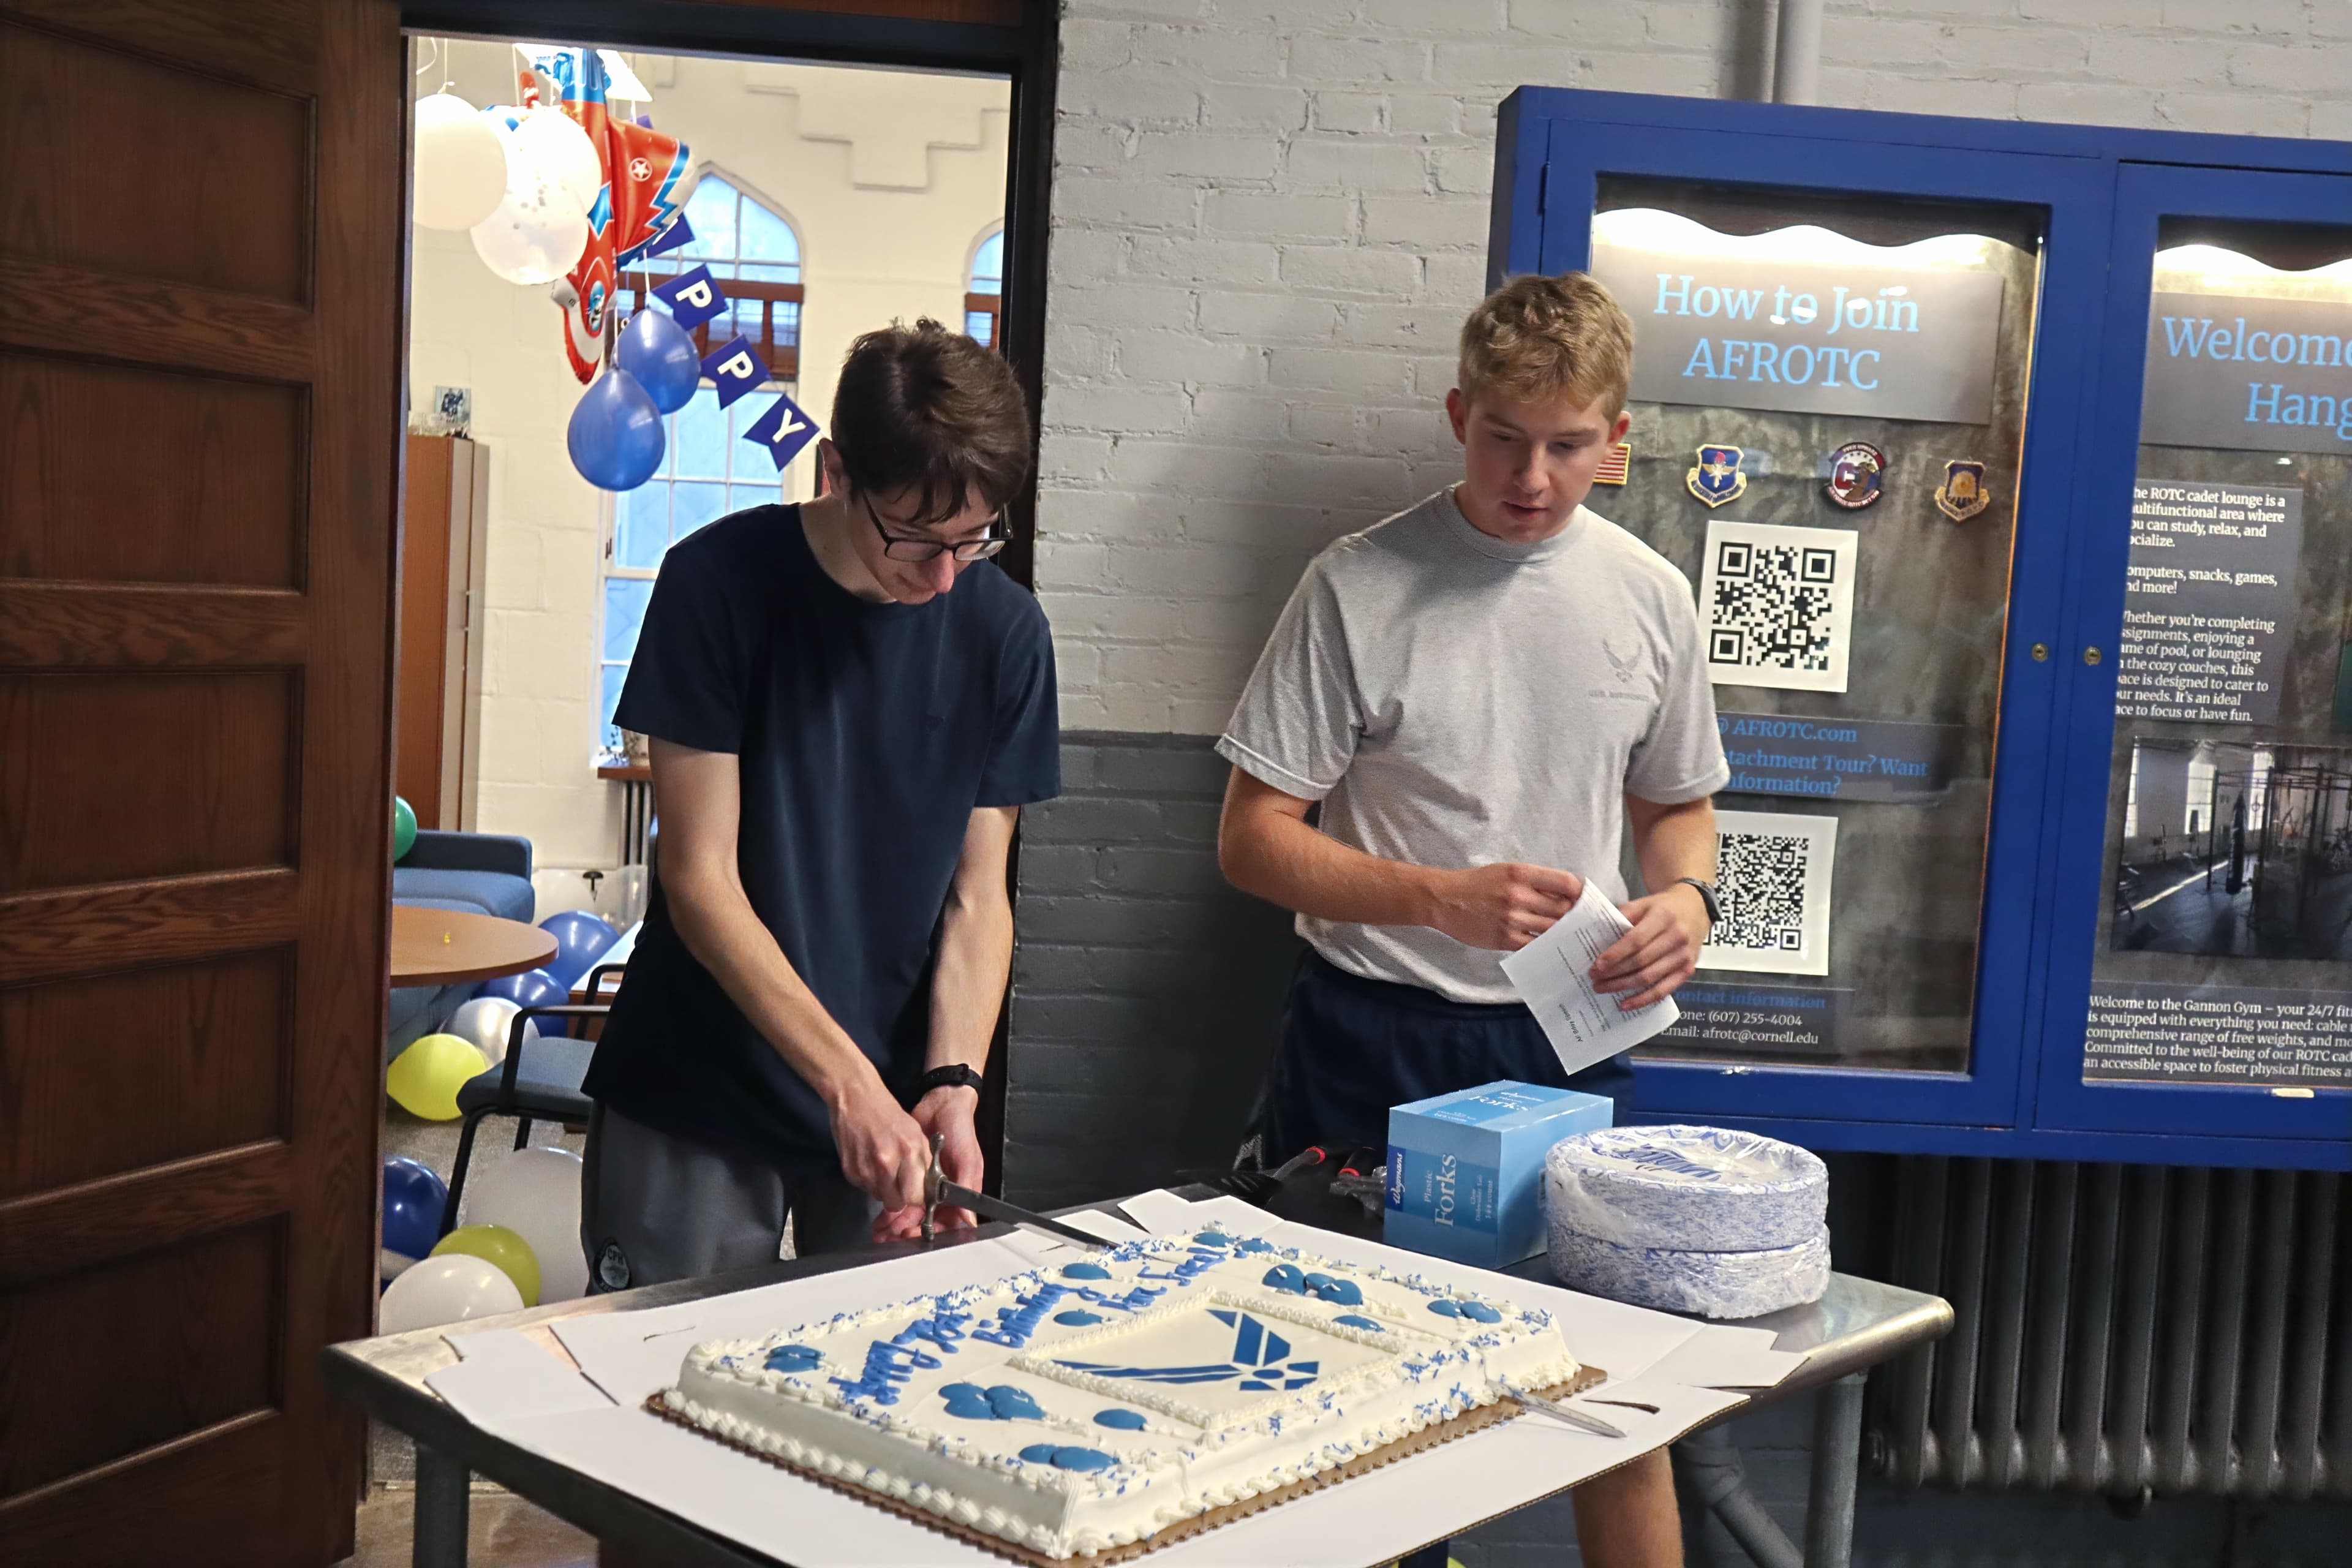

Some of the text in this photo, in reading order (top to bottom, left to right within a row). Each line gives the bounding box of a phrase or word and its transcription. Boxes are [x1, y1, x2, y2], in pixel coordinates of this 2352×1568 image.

[1654, 273, 1919, 334] How to Join
[1682, 337, 1880, 391] AFROTC
[2134, 486, 2285, 508] he ROTC cadet lounge is a
[2132, 502, 2285, 522] ultifunctional area where
[2132, 519, 2267, 538] ou can study, relax, and
[2130, 534, 2175, 547] ocialize.
[2127, 566, 2277, 587] omputers, snacks, games,
[2127, 580, 2177, 594] nd more!
[2169, 614, 2206, 627] you're
[2207, 617, 2275, 633] completing
[2122, 627, 2254, 647] ssignments, enjoying a
[2122, 643, 2262, 663] ame of pool, or lounging
[2127, 657, 2146, 669] the
[2149, 662, 2176, 674] cozy
[2178, 662, 2228, 676] couches,
[2231, 663, 2254, 676] this
[2118, 674, 2268, 692] ace is designed to cater to
[2116, 690, 2241, 706] ur needs. It's an ideal
[2115, 704, 2253, 722] ace to focus or have fun.
[1732, 718, 1858, 743] AFROTC.com
[1728, 750, 1929, 777] tachment Tour? Want
[1728, 772, 1842, 796] nformation?
[1675, 989, 1725, 1005] ontact
[2090, 995, 2144, 1009] Welcome
[2147, 999, 2159, 1009] to
[2162, 998, 2181, 1010] the
[2184, 1000, 2231, 1012] Gannon
[2234, 1001, 2261, 1016] Gym
[2277, 1005, 2305, 1017] your
[2307, 1005, 2334, 1018] 24/7
[1679, 1009, 1803, 1027] one: (607) 255-4004
[2088, 1011, 2098, 1022] is
[2100, 1012, 2157, 1027] equipped
[2159, 1014, 2187, 1026] with
[2189, 1016, 2254, 1031] everything
[2257, 1020, 2278, 1031] you
[2282, 1019, 2314, 1031] need:
[2316, 1020, 2347, 1032] cable
[1702, 1027, 1819, 1044] afrotc@cornell.edu
[2086, 1028, 2178, 1041] comprehensive
[2180, 1031, 2215, 1045] range
[2217, 1031, 2229, 1041] of
[2232, 1031, 2255, 1044] free
[2257, 1033, 2307, 1048] weights,
[2309, 1035, 2332, 1047] and
[2085, 1041, 2153, 1055] Committed
[2155, 1045, 2168, 1056] to
[2170, 1044, 2190, 1057] the
[2192, 1046, 2255, 1061] well-being
[2257, 1048, 2271, 1060] of
[2272, 1050, 2293, 1060] our
[2296, 1049, 2330, 1061] ROTC
[2084, 1059, 2098, 1068] an
[2101, 1058, 2161, 1071] accessible
[2163, 1062, 2196, 1074] space
[2199, 1061, 2212, 1072] to
[2214, 1061, 2248, 1074] foster
[2250, 1062, 2299, 1077] physical
[2302, 1064, 2342, 1077] fitness
[1392, 1152, 1404, 1205] Wegmans
[1423, 1170, 1433, 1204] Plastic
[1434, 1153, 1457, 1228] Forks
[828, 1340, 942, 1405] Happy
